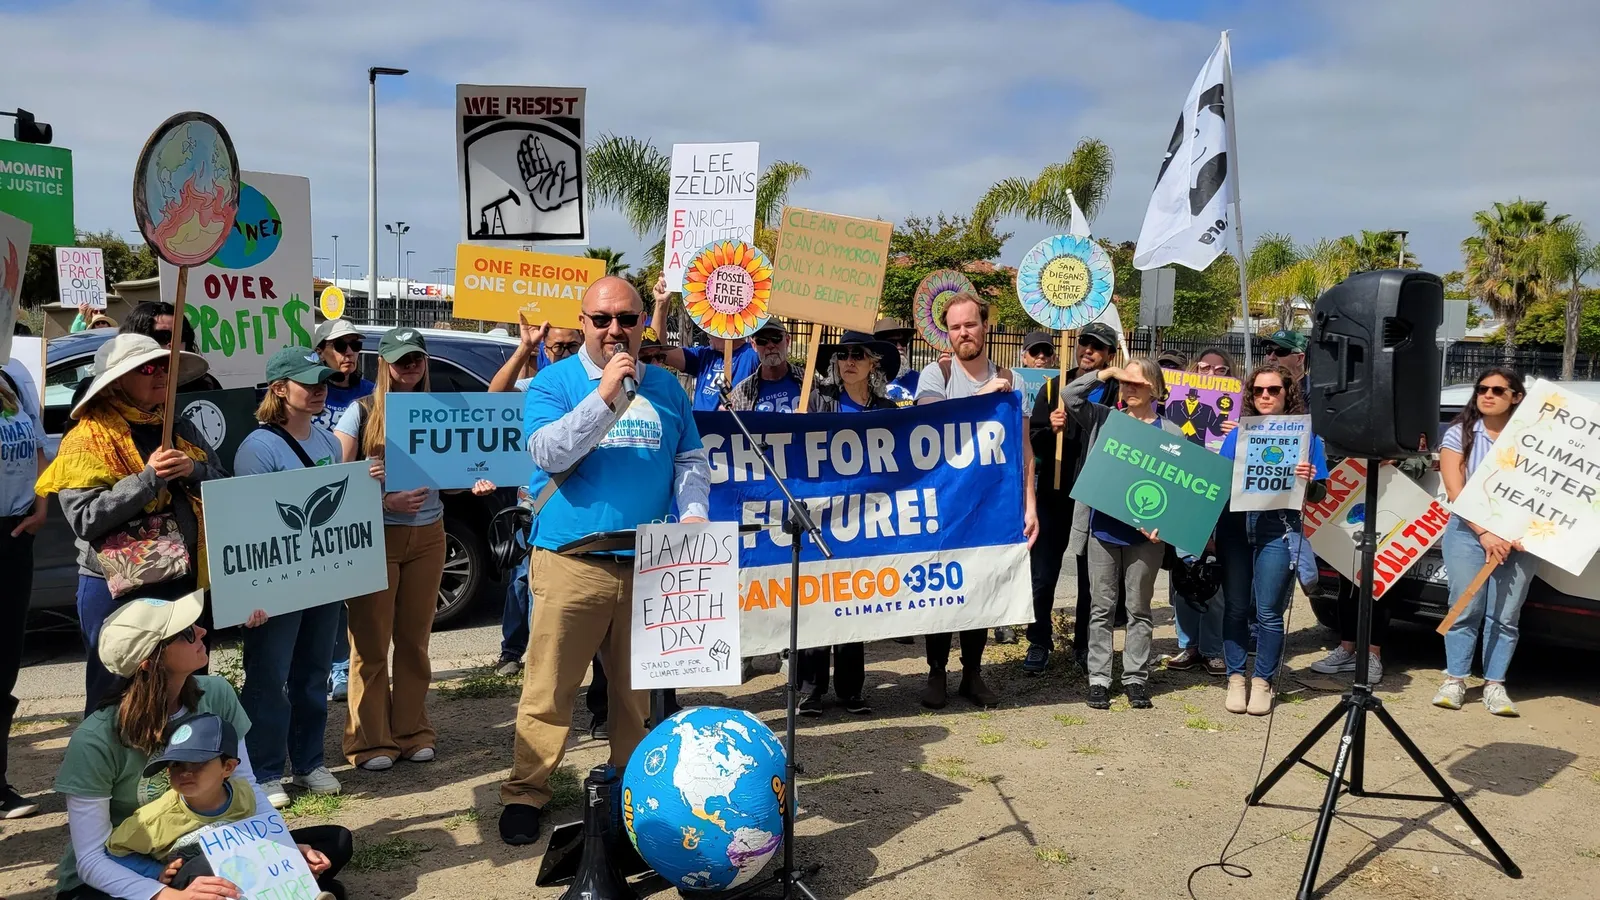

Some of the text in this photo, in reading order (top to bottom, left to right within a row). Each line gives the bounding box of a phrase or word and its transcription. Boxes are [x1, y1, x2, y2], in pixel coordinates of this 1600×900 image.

[464, 97, 578, 115] WE RESIST
[0, 161, 63, 179] MOMENT
[693, 153, 734, 172] LEE
[7, 178, 63, 195] JUSTICE
[675, 171, 756, 195] ZELDIN'S
[234, 219, 282, 241] NET
[788, 212, 883, 243] CLEAN COAL
[782, 232, 794, 249] IS
[795, 236, 812, 252] AN
[62, 250, 100, 265] DON'T
[1058, 262, 1075, 271] SAN
[60, 264, 103, 279] FRACK
[474, 258, 588, 283] ONE REGION
[717, 271, 746, 284] FOSSIL
[778, 254, 878, 288] ONLY A MORON
[1049, 270, 1084, 280] DIEGANS
[72, 278, 100, 290] OUR
[204, 274, 277, 301] OVER
[408, 285, 441, 296] FedEx
[464, 274, 588, 300] ONE CLIMAT
[715, 283, 743, 296] FREE
[773, 279, 811, 297] WOULD
[813, 284, 861, 307] BELIEVE
[1047, 284, 1080, 292] CLIMATE
[62, 288, 105, 306] FUTURE
[713, 294, 744, 307] FUTURE
[1163, 370, 1181, 386] AKE
[1182, 373, 1242, 393] POLLUTERS
[766, 391, 788, 401] DIEGO
[409, 408, 524, 423] PROTECT OU
[1539, 402, 1600, 442] PROT
[1245, 422, 1304, 431] Lee Zeldin
[1, 440, 35, 461] CTION
[409, 427, 529, 454] FUTUR
[1250, 437, 1276, 445] DON'T
[1568, 439, 1585, 450] our
[703, 421, 1006, 484] GHT FOR OUR
[1103, 438, 1220, 501] RESILIENCE
[1247, 465, 1294, 477] FOSSIL
[1514, 454, 1596, 503] WATER
[1245, 477, 1291, 491] FOOL
[1534, 486, 1553, 498] and
[1493, 482, 1577, 530] HEALTH
[742, 488, 939, 549] FUTURE!
[1402, 501, 1450, 547] TIME
[223, 520, 373, 576] CLIMATE ACTION
[640, 532, 733, 571] HANDS
[251, 560, 353, 587] CAMPAIGN
[661, 568, 712, 593] OFF
[643, 592, 723, 626] EARTH
[834, 595, 965, 617] CLIMATE ACTION
[660, 624, 706, 652] DAY
[641, 661, 670, 671] STAND
[650, 666, 712, 679] CLIMATE JUSTICE
[200, 814, 284, 856] HANDS
